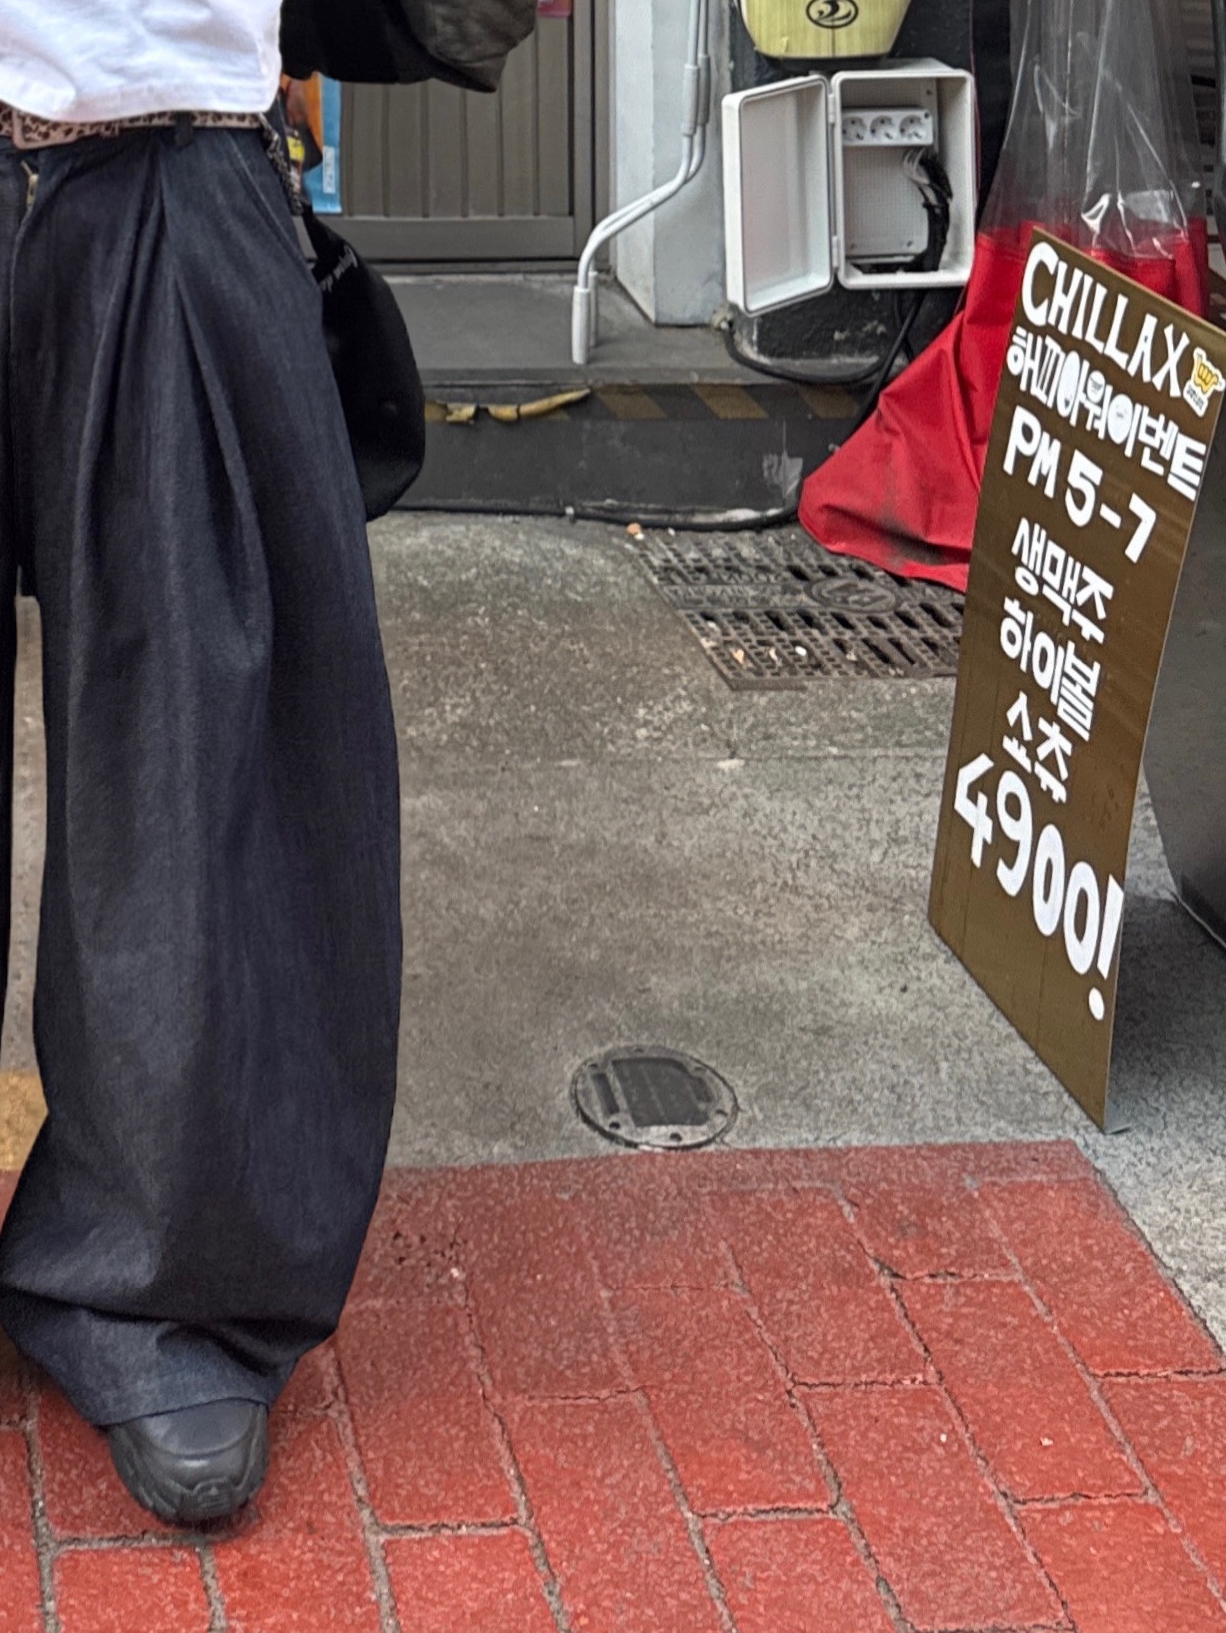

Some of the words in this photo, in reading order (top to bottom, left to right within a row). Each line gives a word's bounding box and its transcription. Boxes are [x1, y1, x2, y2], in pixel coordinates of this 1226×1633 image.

[1022, 242, 1190, 397] CHILLAX
[1003, 405, 1061, 499] PM
[1064, 449, 1156, 563] 5-7
[1011, 517, 1114, 644] 생맥주
[1000, 596, 1101, 742] 하이볼
[1002, 691, 1072, 803] 소주
[954, 753, 1124, 1021] 4900!
